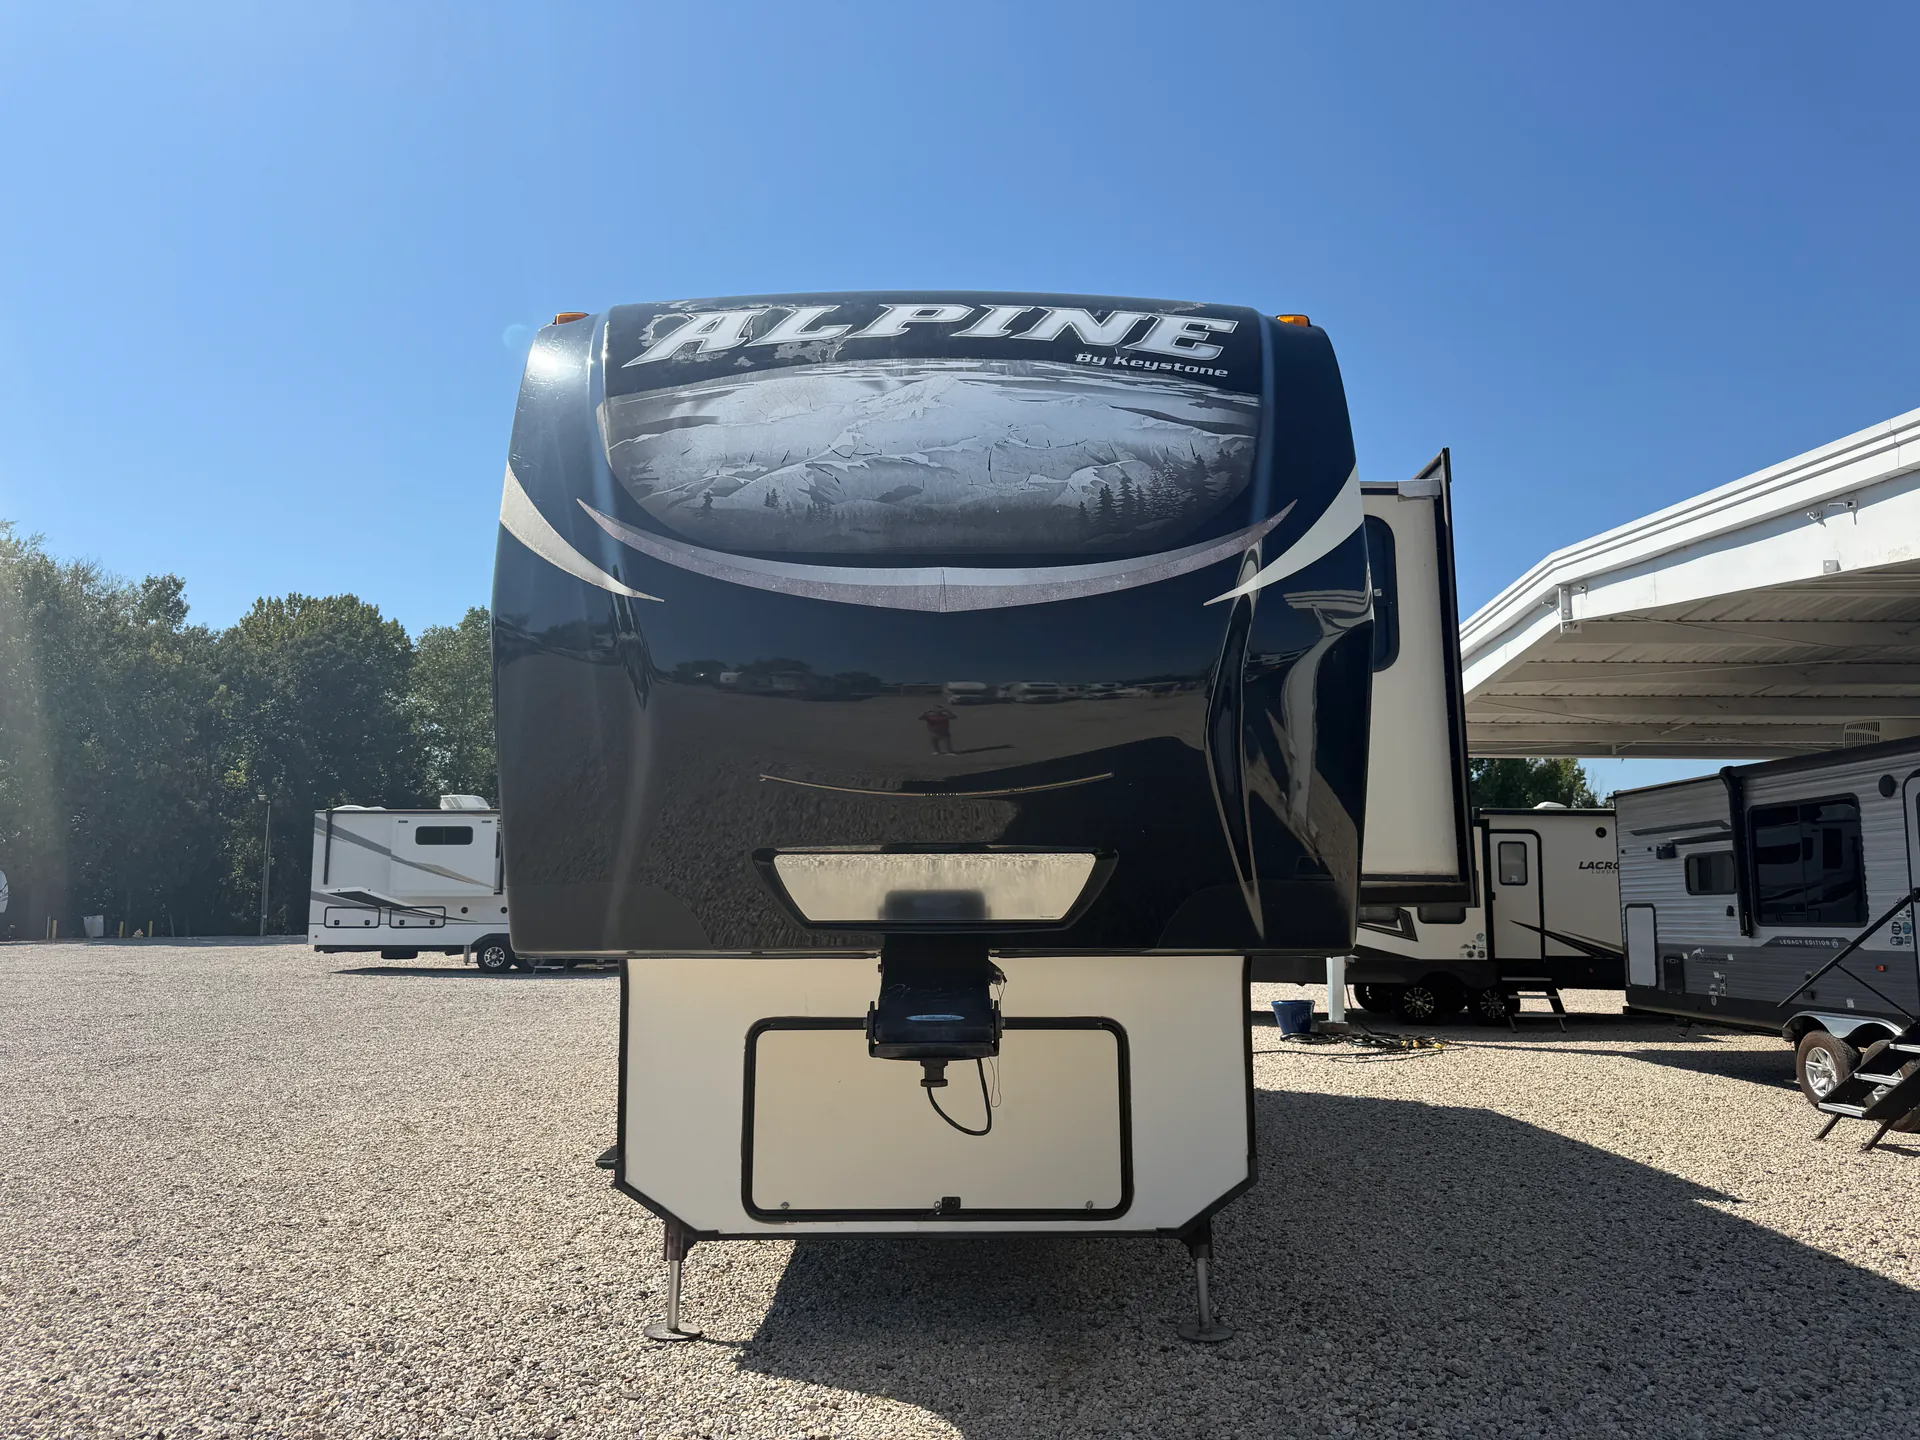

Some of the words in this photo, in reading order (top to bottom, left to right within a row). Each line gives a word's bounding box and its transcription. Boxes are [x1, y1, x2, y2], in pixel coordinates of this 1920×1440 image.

[621, 303, 1239, 367] ALPINE
[1075, 352, 1107, 366] By
[1113, 356, 1229, 377] Keystone
